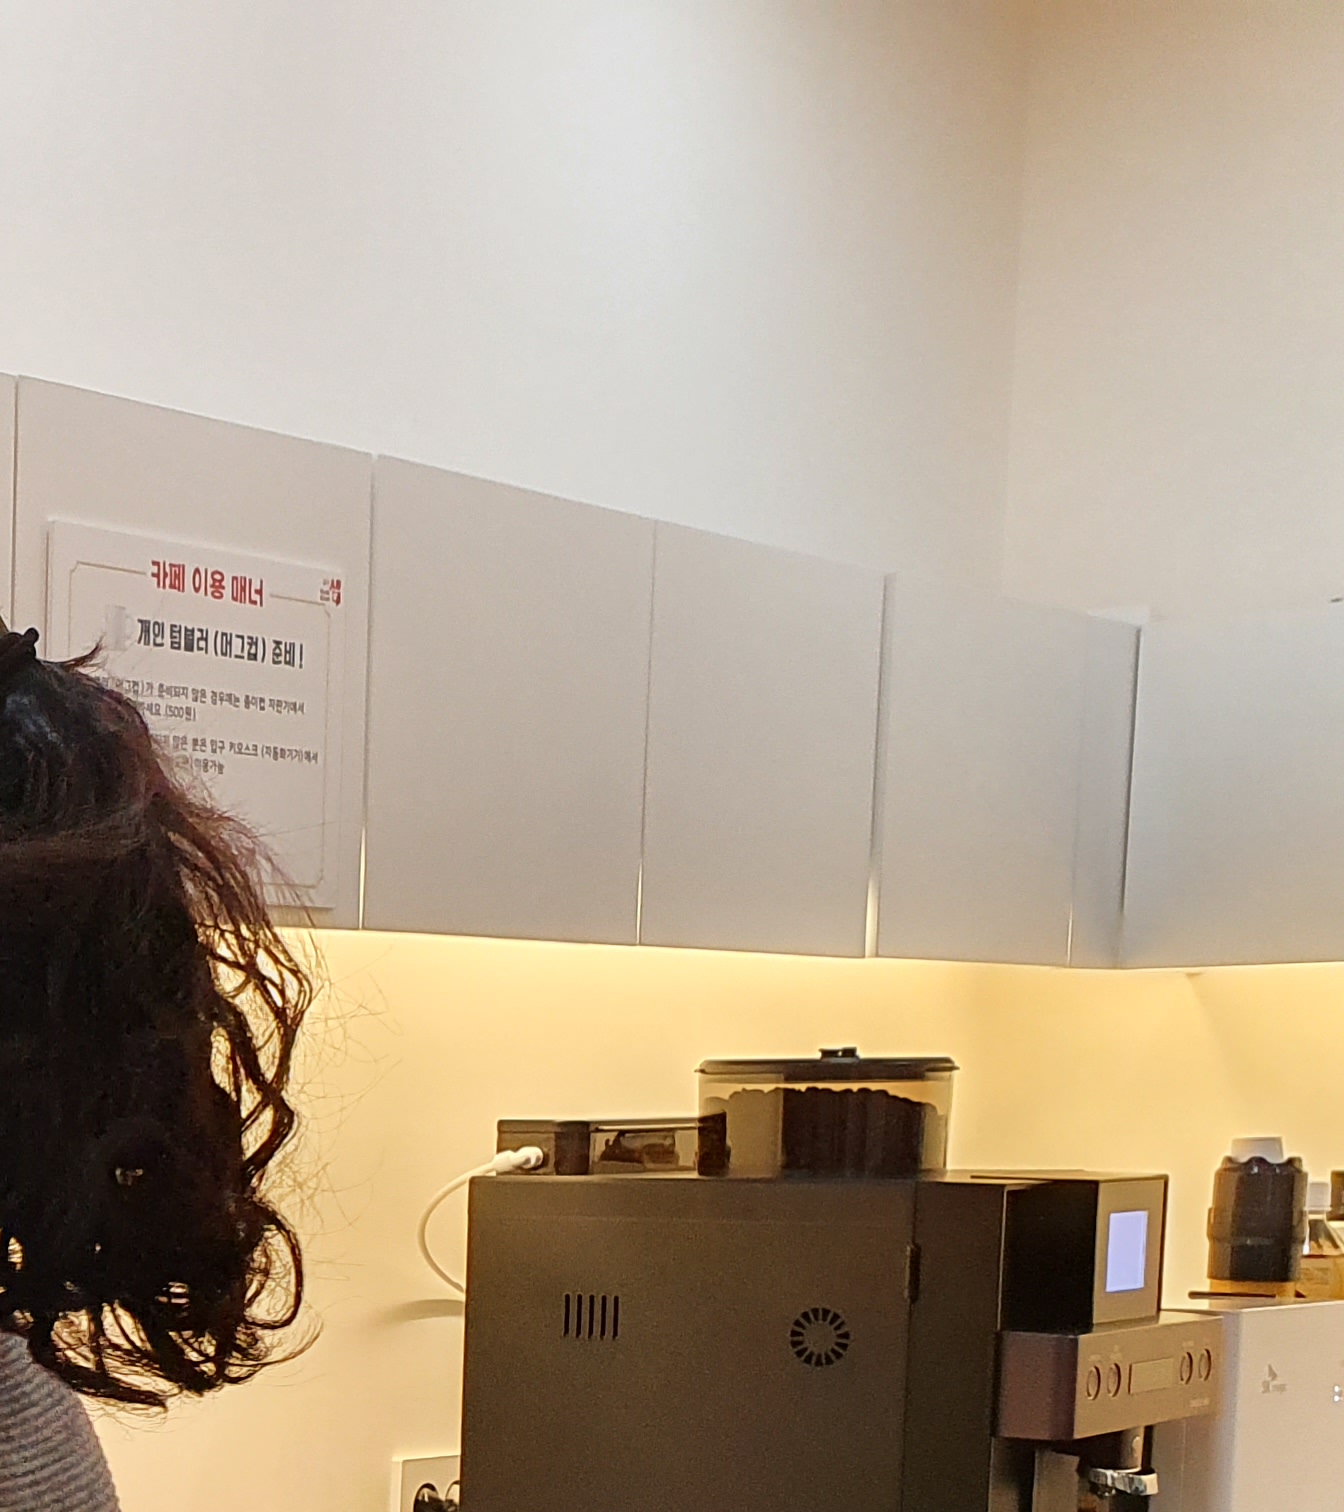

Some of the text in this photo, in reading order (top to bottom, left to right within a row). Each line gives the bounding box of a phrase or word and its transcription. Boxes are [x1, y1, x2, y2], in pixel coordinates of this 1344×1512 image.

[151, 559, 264, 607] 카페 이용 매너
[137, 618, 266, 664] 개인 텀블러 (머그컵)
